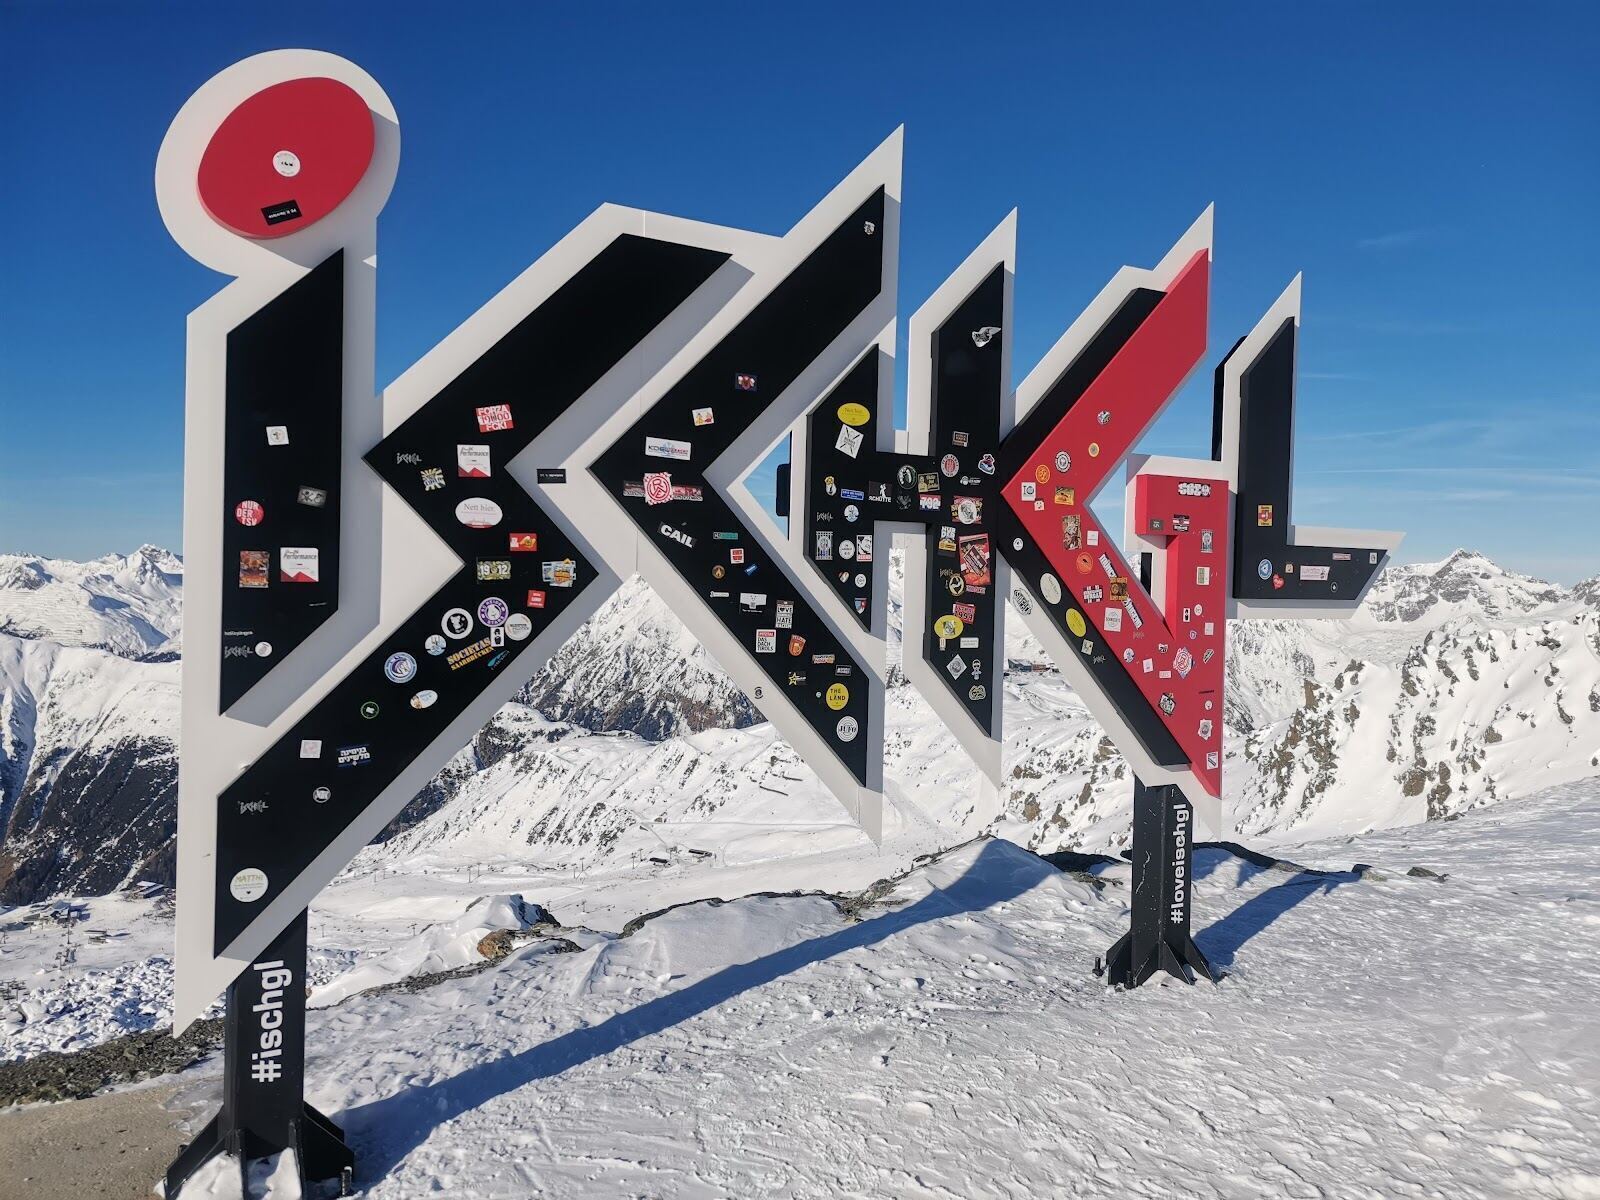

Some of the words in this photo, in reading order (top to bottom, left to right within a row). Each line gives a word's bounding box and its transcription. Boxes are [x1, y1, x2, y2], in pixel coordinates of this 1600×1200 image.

[476, 404, 510, 417] FORZA
[241, 500, 260, 510] NUR
[463, 503, 479, 512] Nett
[236, 508, 254, 518] DER
[660, 524, 693, 548] CAIL
[282, 552, 318, 560] Performance
[1170, 803, 1189, 924] #loveischgl
[251, 960, 292, 1082] #ischgl
